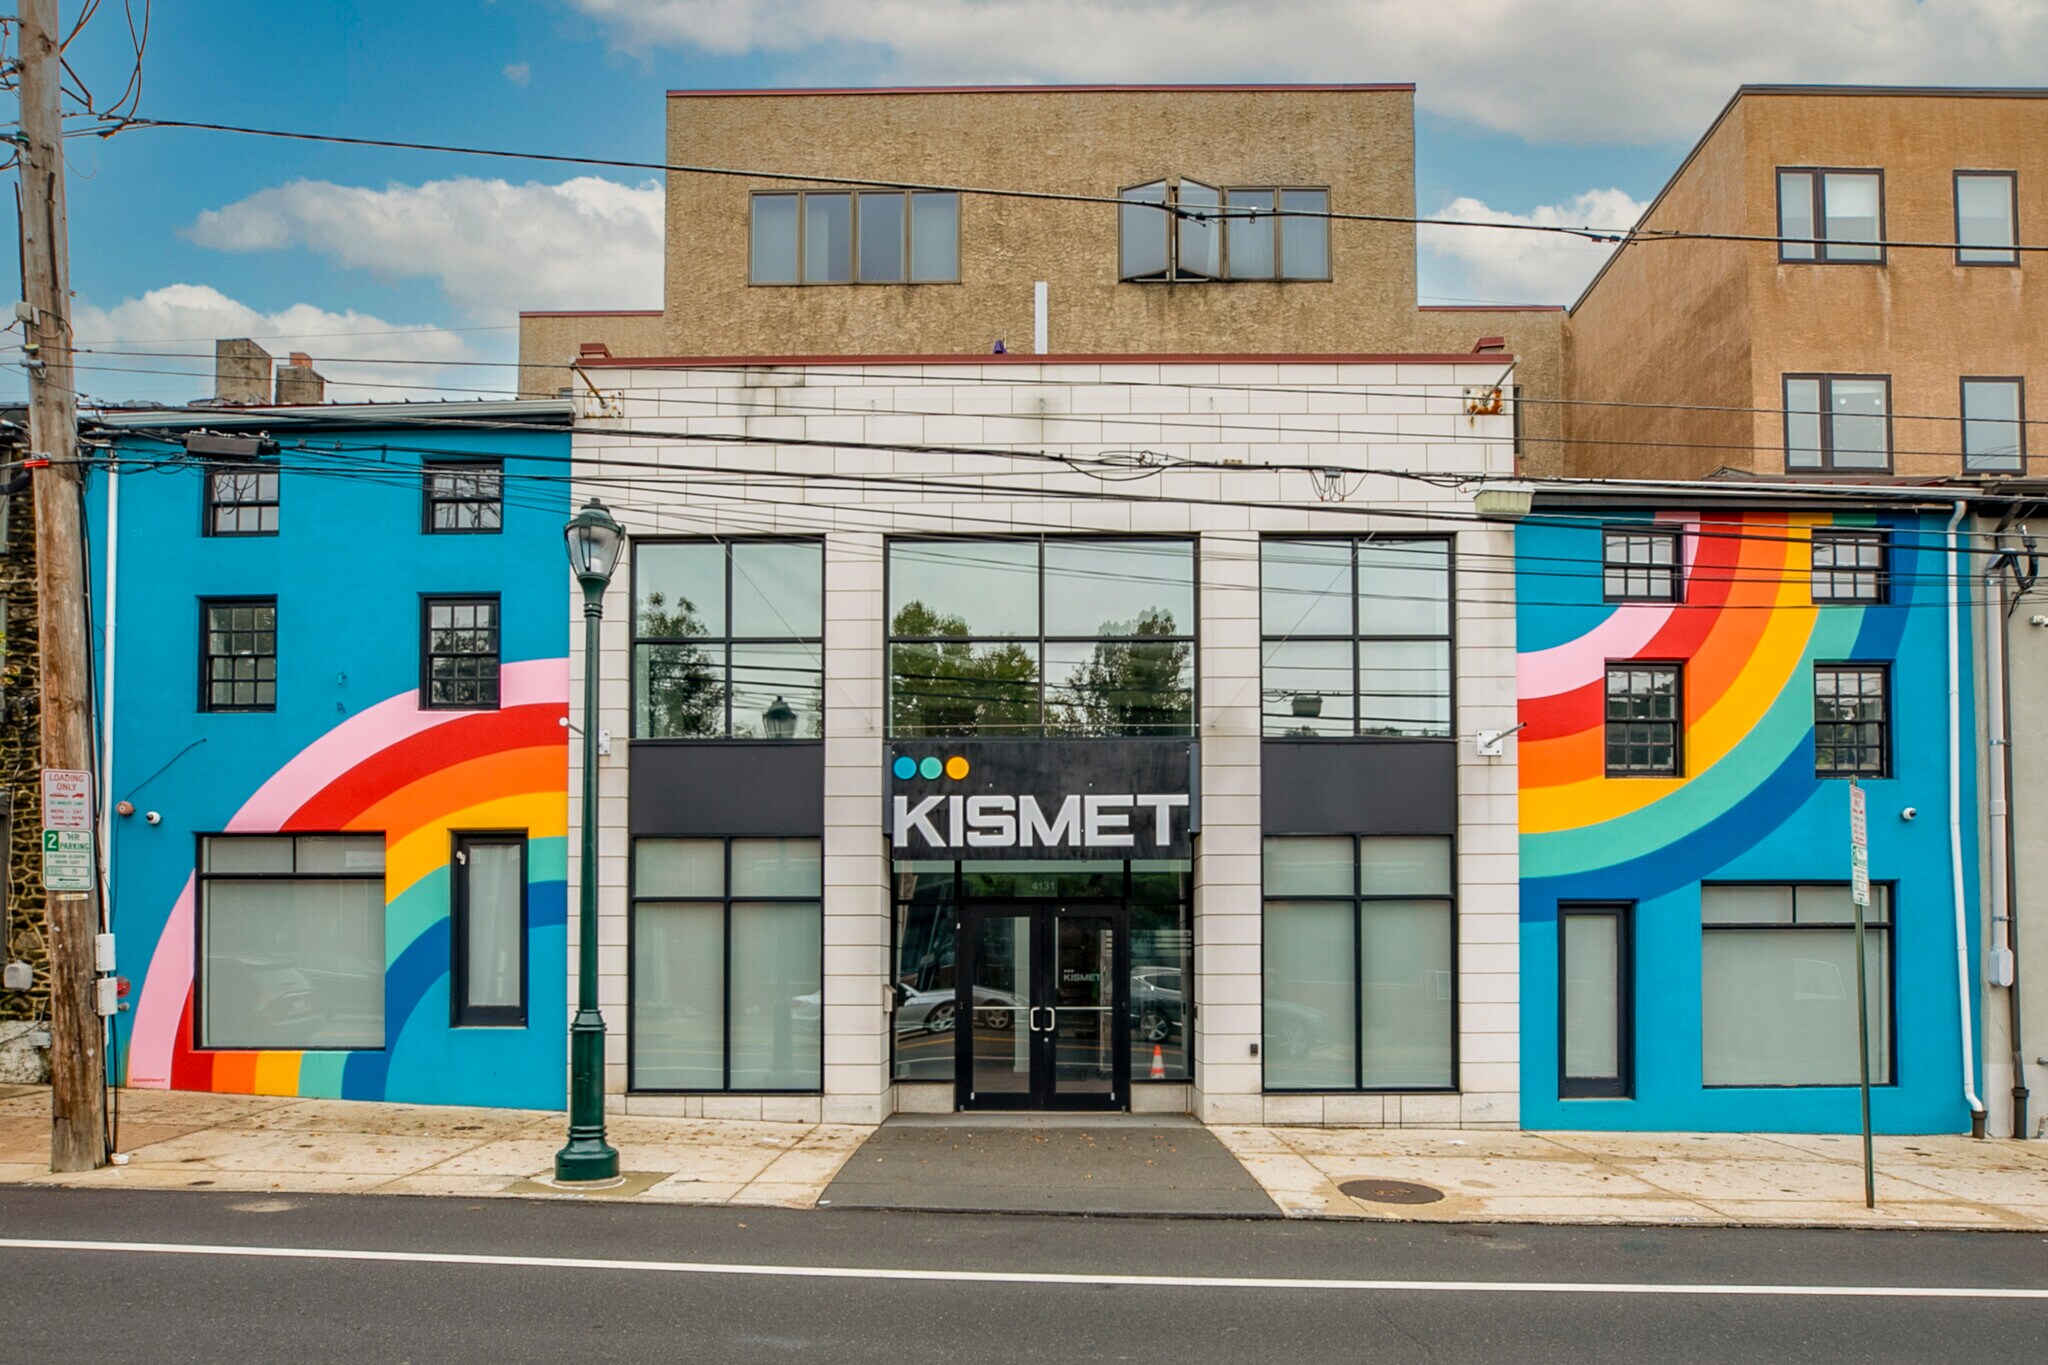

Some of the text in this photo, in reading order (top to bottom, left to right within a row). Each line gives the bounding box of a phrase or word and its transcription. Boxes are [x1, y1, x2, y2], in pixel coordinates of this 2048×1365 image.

[49, 774, 84, 782] LOADING
[56, 783, 77, 791] ONLY
[893, 794, 1189, 848] KISMET
[47, 833, 80, 849] 2 HR
[59, 842, 90, 851] PARKING
[1031, 881, 1055, 891] 4131
[1063, 973, 1101, 982] KISMET
